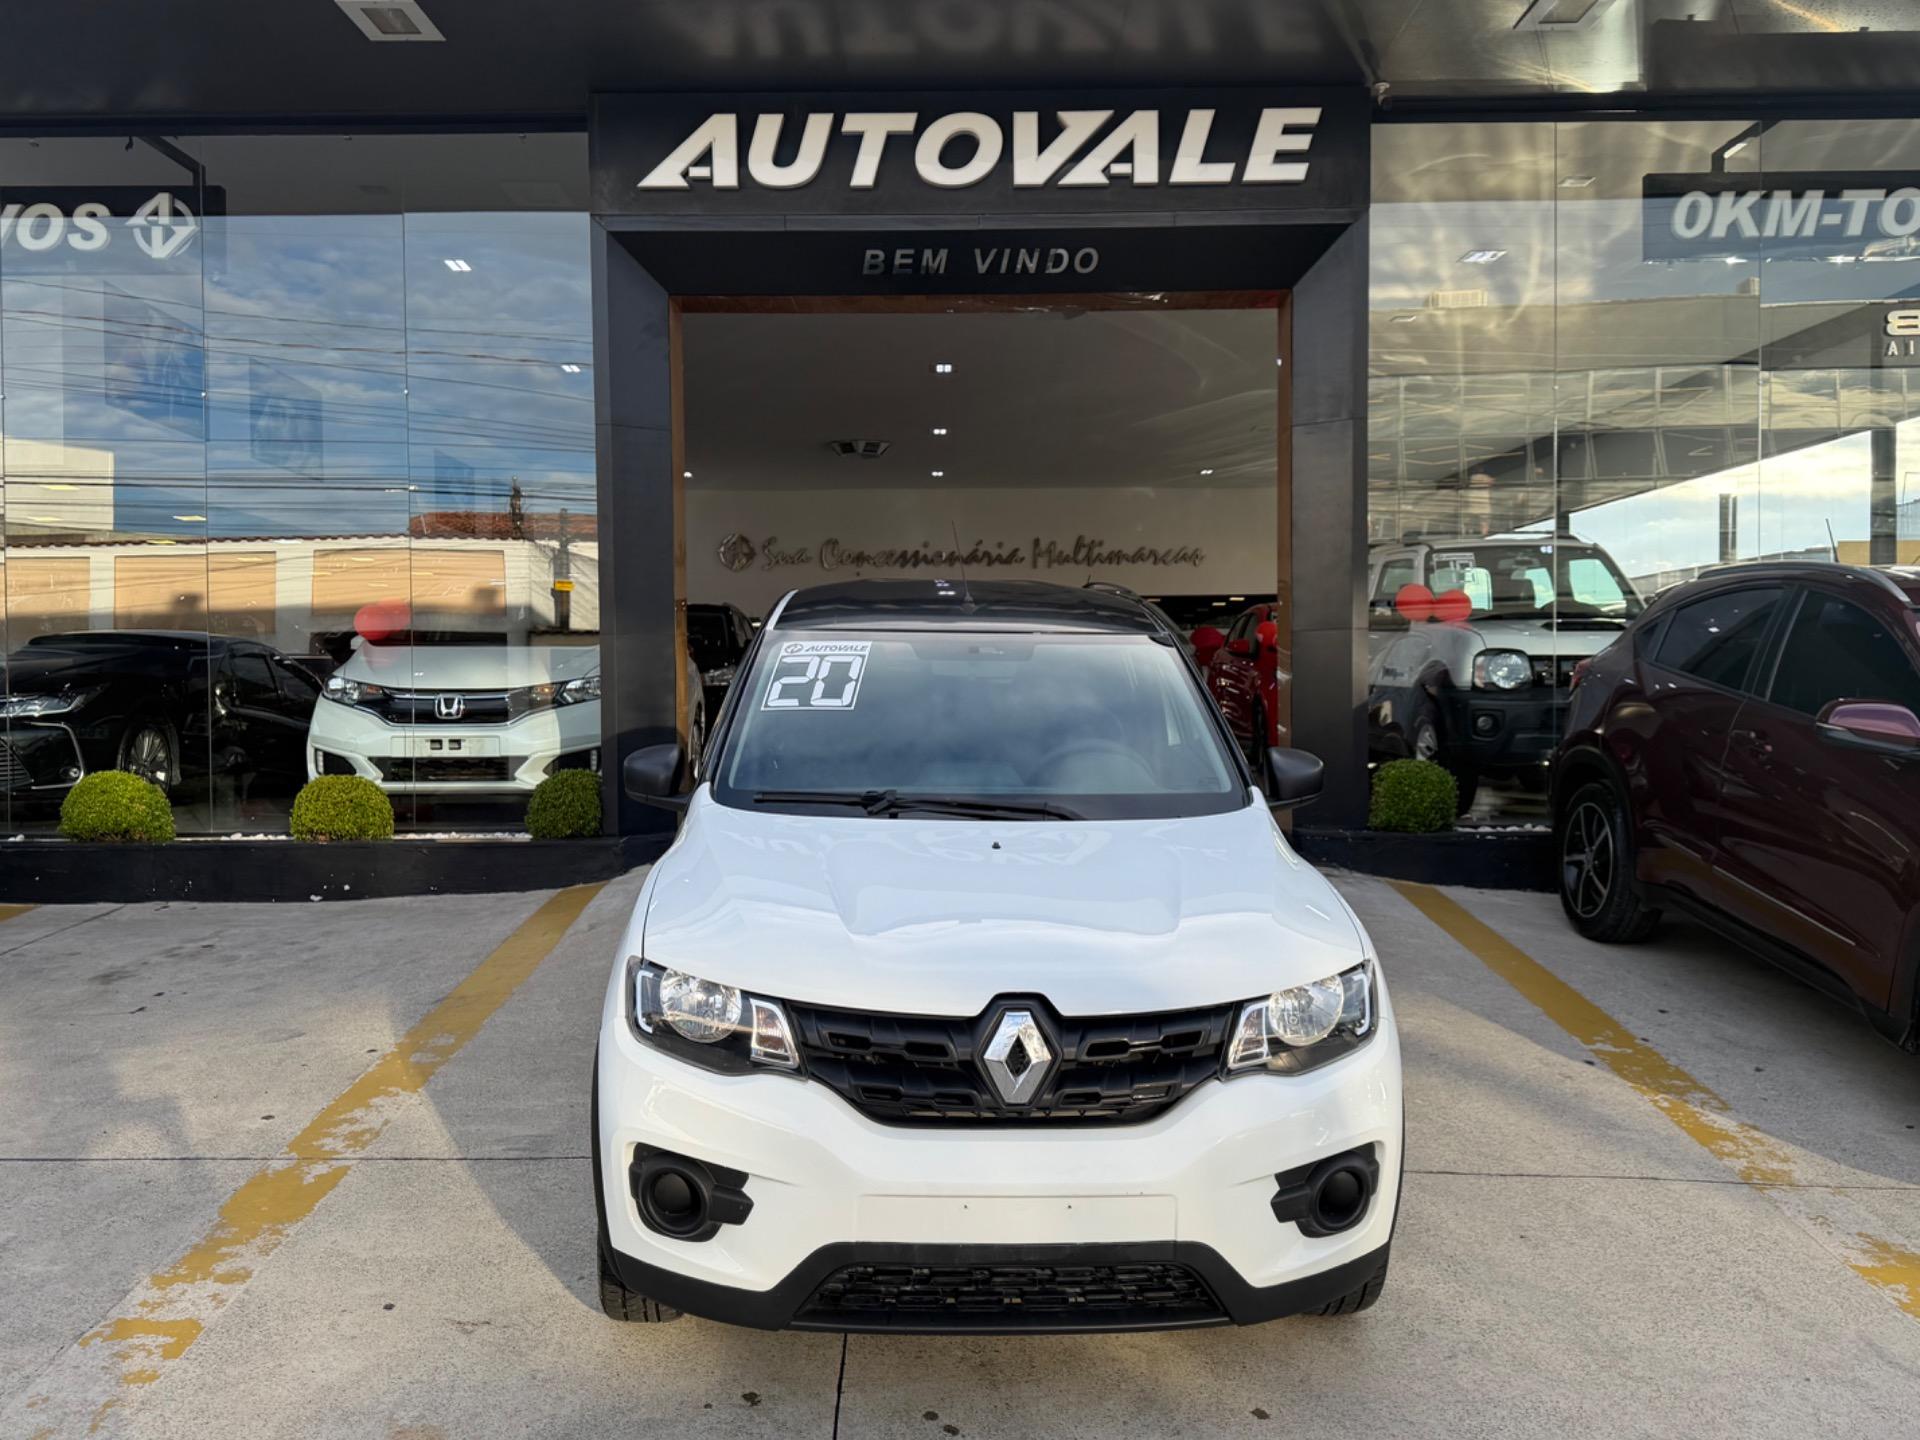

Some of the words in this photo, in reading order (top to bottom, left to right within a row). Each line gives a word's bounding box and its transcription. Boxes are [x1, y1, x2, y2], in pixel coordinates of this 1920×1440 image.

[637, 106, 1322, 189] AUTOVALE
[863, 248, 949, 275] BEM
[974, 247, 1099, 275] VINDO
[805, 643, 869, 653] AUTOVALE
[767, 655, 863, 706] 20
